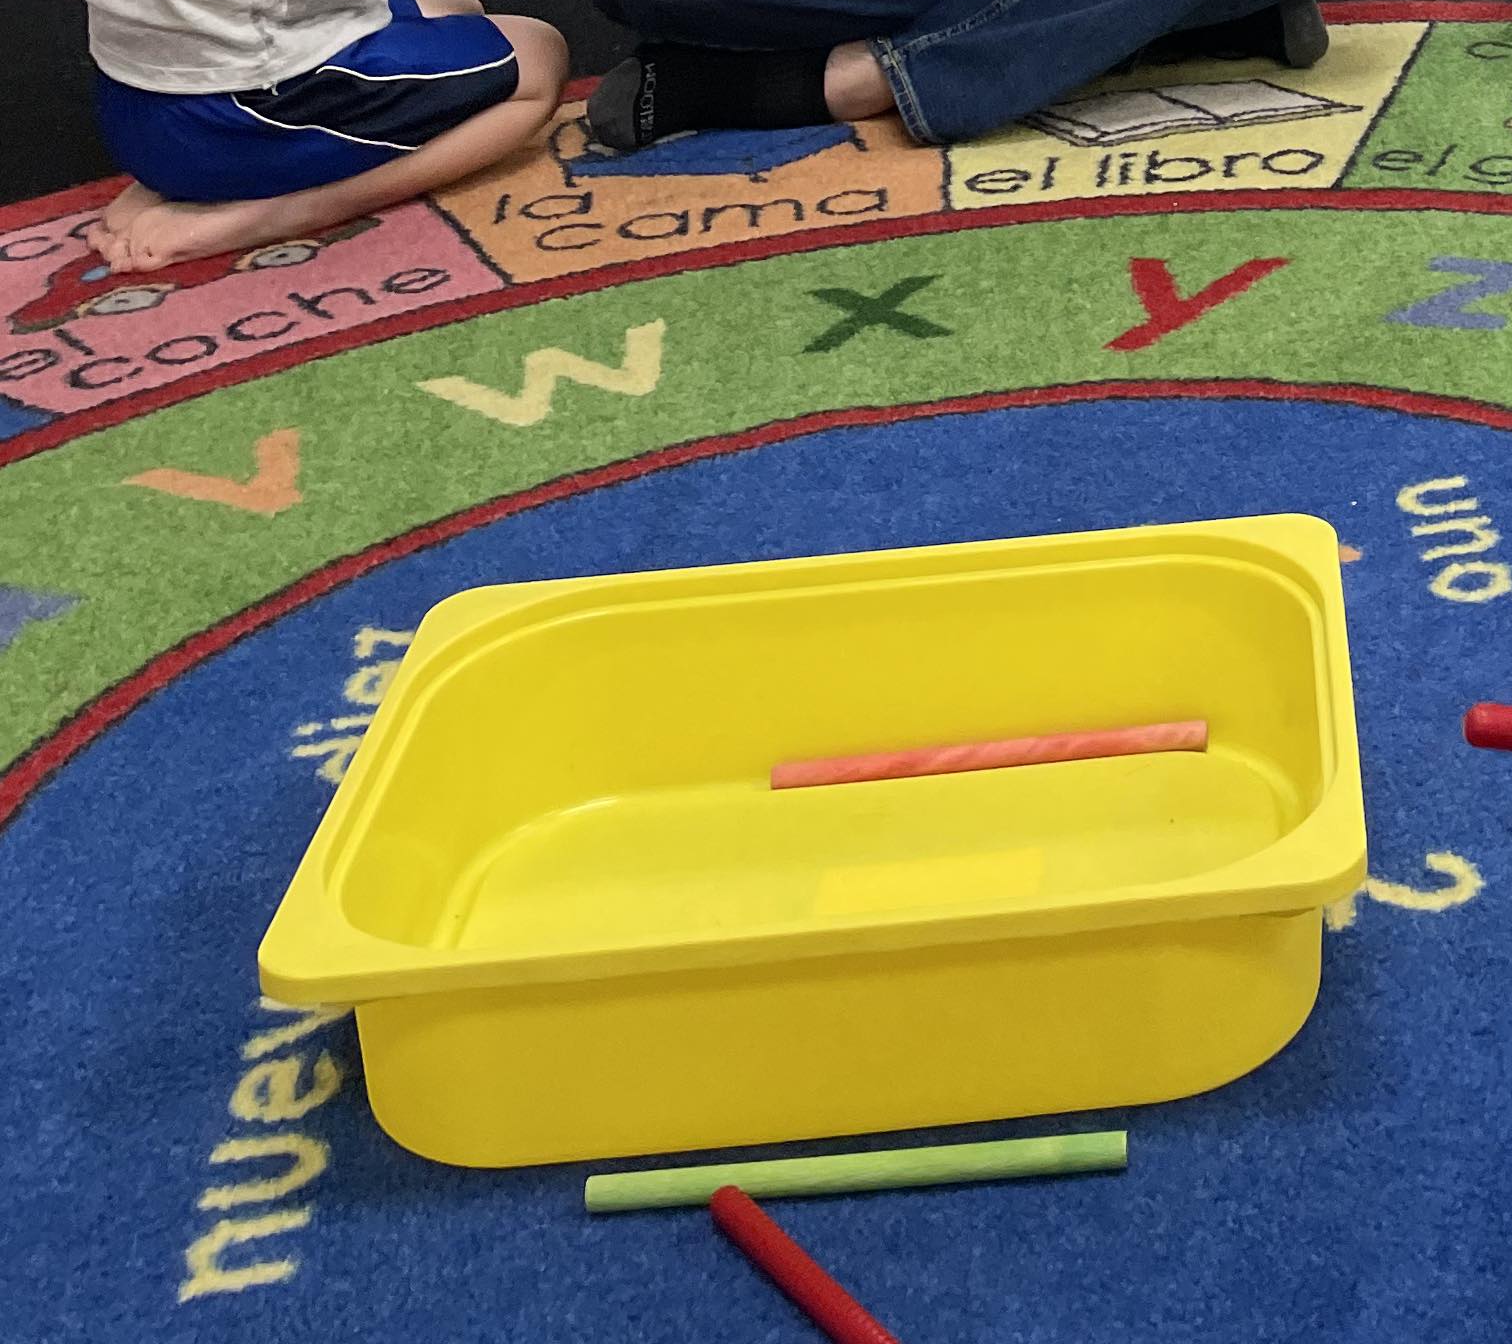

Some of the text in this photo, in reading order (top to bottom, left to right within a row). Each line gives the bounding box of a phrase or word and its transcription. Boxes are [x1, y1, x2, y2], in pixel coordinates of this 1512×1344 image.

[964, 145, 1326, 196] el libro
[1372, 144, 1457, 177] el
[492, 192, 593, 224] la
[535, 187, 889, 251] cama
[64, 265, 451, 390] coche
[178, 995, 356, 1304] nuev
